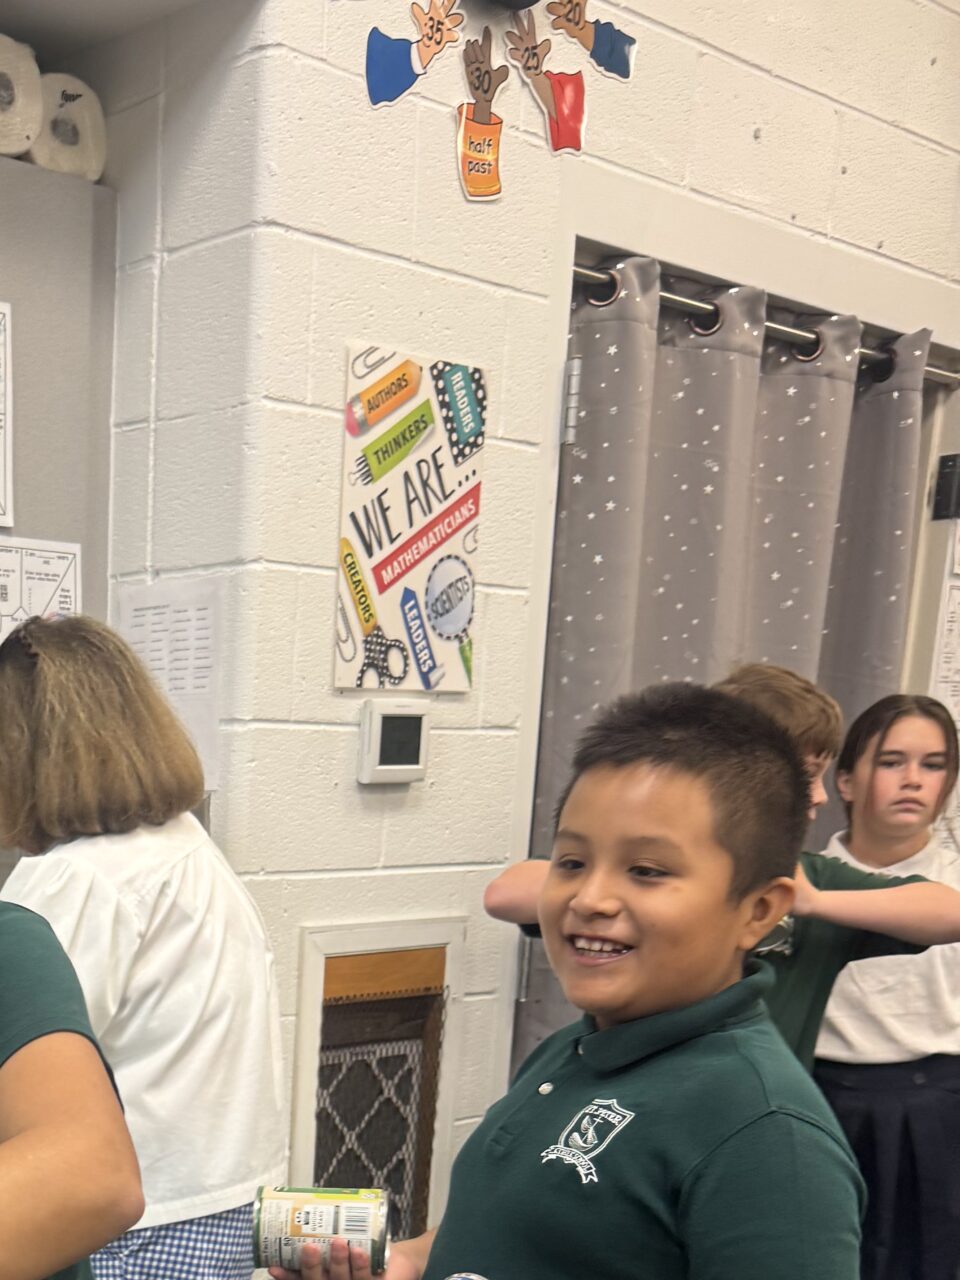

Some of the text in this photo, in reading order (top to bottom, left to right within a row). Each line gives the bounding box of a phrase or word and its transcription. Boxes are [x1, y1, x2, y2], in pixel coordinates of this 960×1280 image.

[467, 159, 492, 176] past
[468, 136, 492, 155] half
[366, 372, 409, 414] AUTHORS
[450, 371, 476, 434] READERS
[373, 413, 430, 467] THINKERS
[349, 488, 401, 560] WE
[381, 499, 476, 586] MATHEMATICIANS
[342, 552, 374, 624] CREATORS
[430, 575, 471, 621] SCIENTISTS
[404, 600, 433, 674] LEADERS
